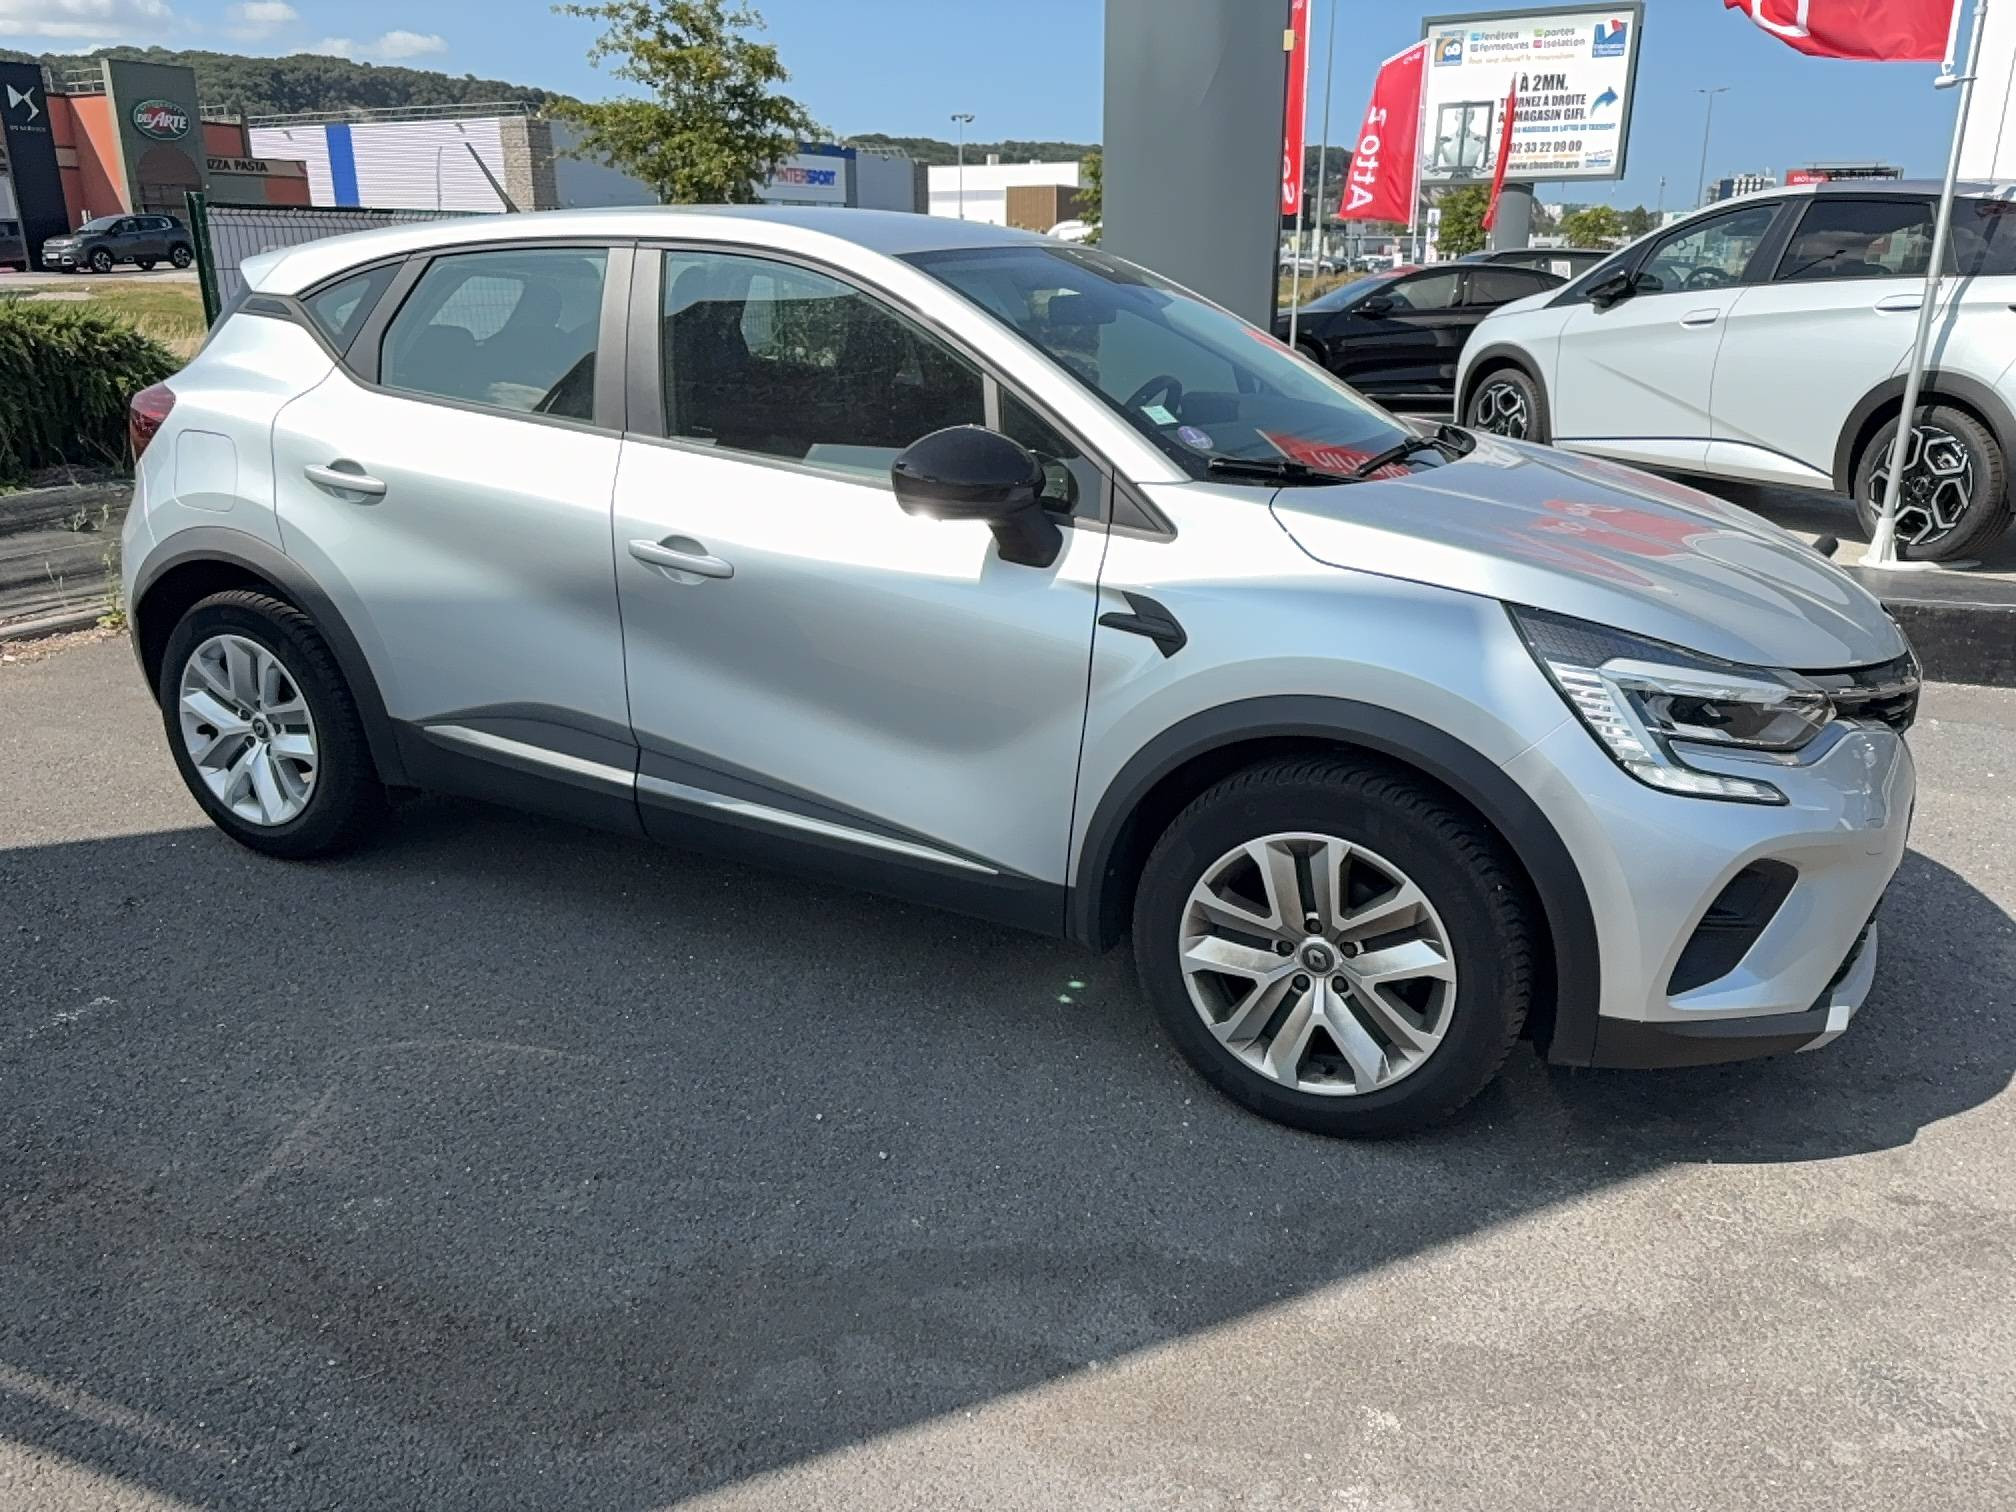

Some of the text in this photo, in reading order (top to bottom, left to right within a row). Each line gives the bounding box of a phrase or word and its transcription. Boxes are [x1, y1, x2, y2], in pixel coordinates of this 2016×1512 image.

[1543, 28, 1575, 38] portes
[1543, 38, 1586, 48] isolation
[1519, 72, 1569, 92] À 2MN,
[1500, 95, 1542, 108] TRNEZ
[1551, 94, 1586, 107] DROITE
[1513, 108, 1561, 122] MAGASIN
[1564, 106, 1586, 120] GIFI.
[147, 112, 187, 132] ARTE
[1524, 142, 1537, 153] 33
[1537, 141, 1552, 153] 22
[207, 158, 268, 172] IZZA PASTA
